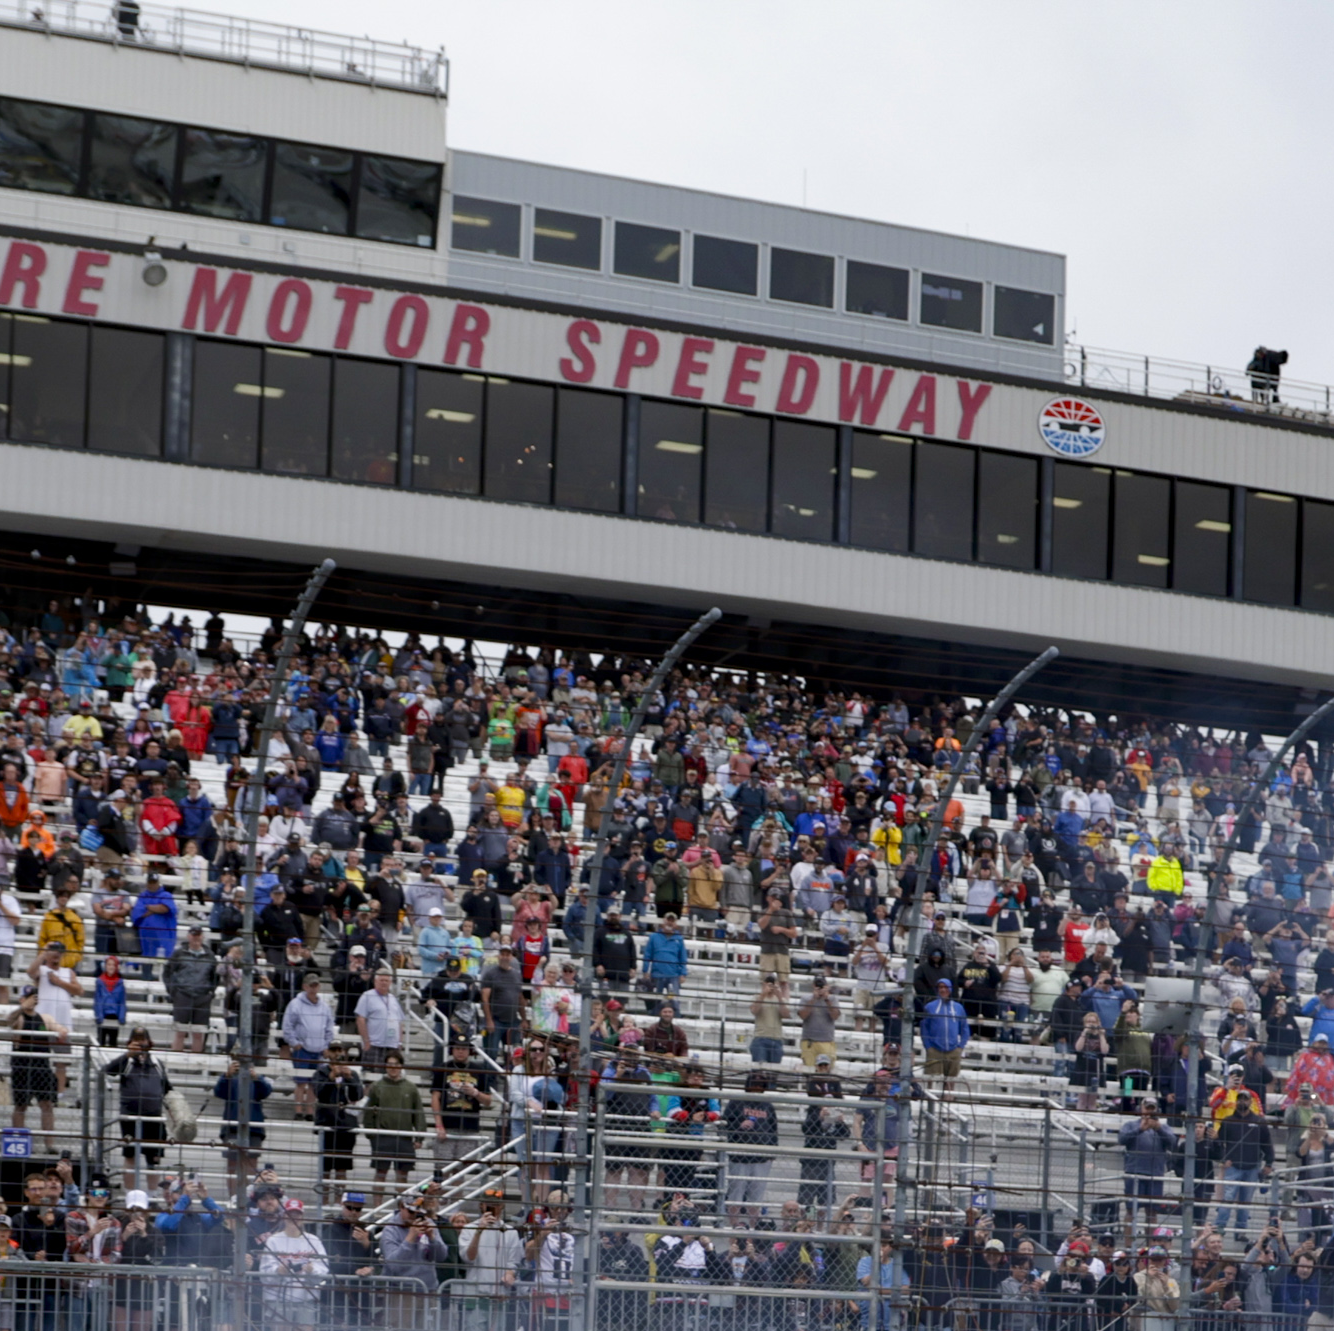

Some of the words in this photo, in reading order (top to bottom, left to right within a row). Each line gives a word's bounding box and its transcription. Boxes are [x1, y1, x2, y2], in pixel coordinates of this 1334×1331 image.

[183, 266, 491, 368] MOTOR
[560, 319, 992, 440] SPEEDWAY
[7, 1143, 26, 1155] 45
